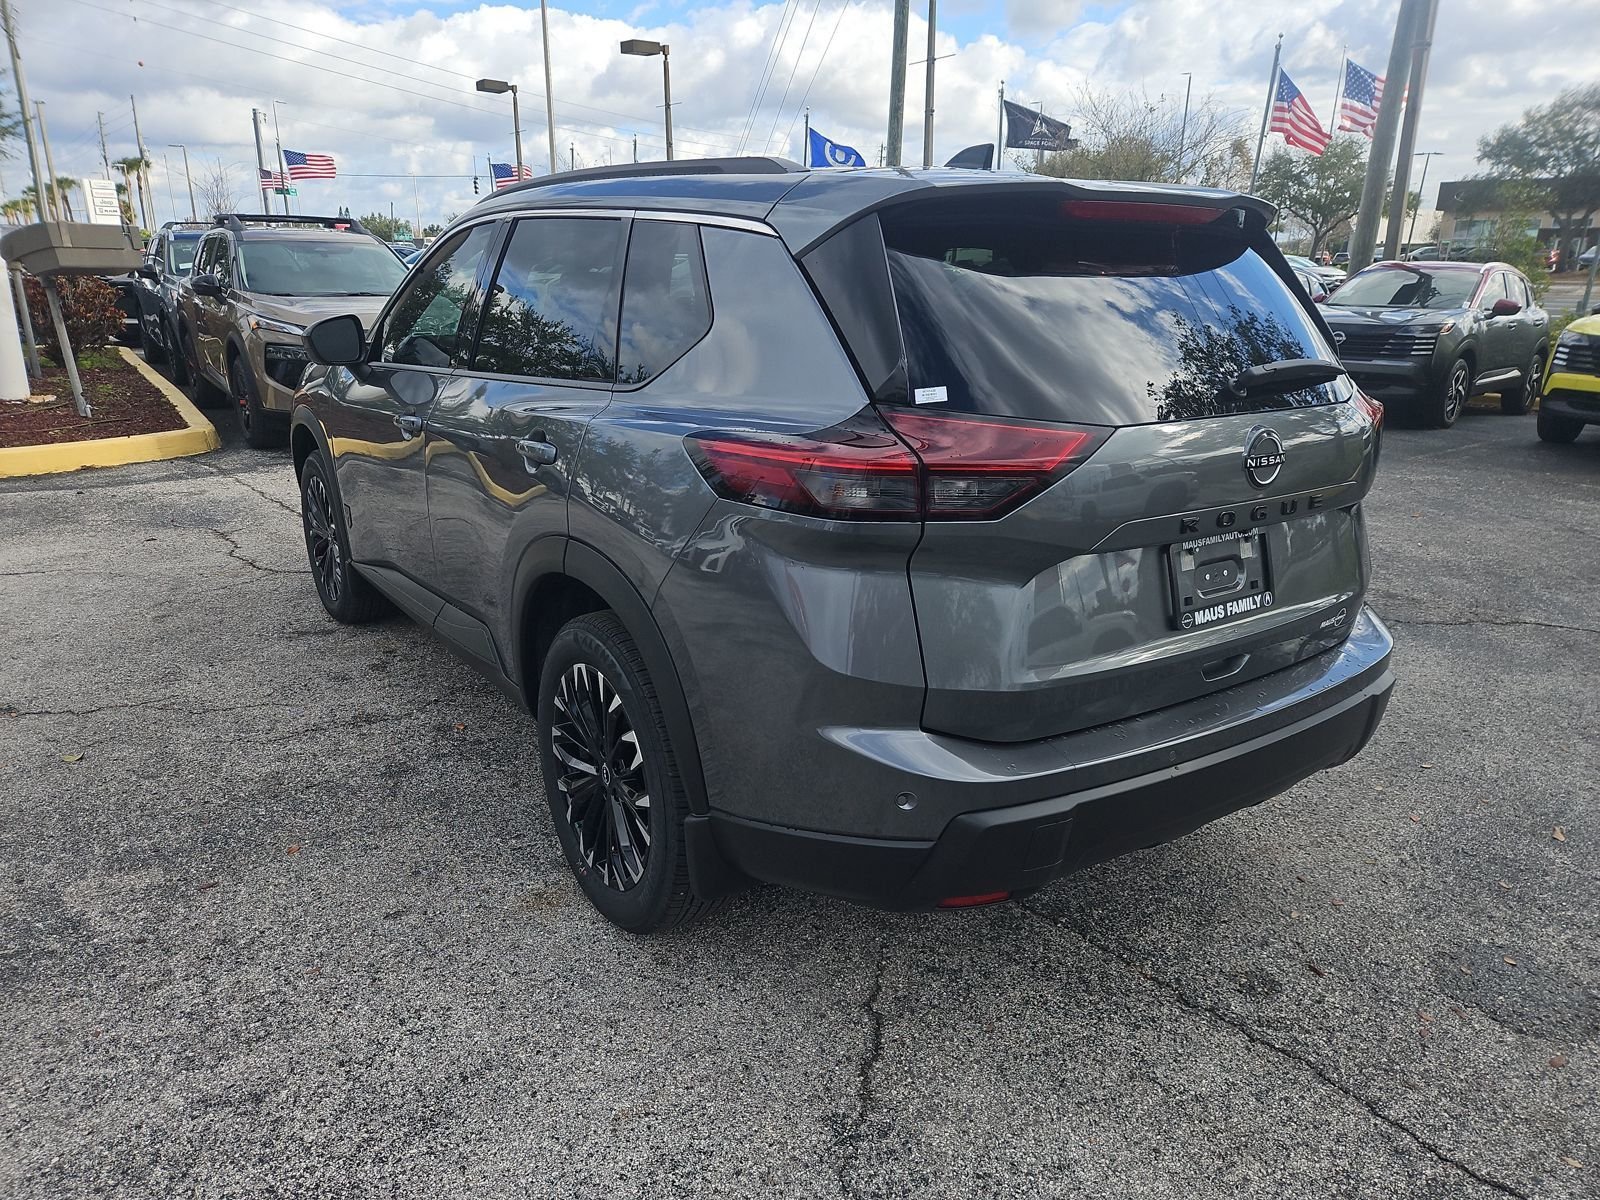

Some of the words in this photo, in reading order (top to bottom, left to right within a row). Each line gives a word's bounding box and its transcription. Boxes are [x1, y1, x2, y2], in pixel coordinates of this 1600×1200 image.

[1247, 453, 1286, 468] NISSAN
[1180, 494, 1323, 535] ROGUE
[1194, 604, 1225, 626] MAUS
[1226, 594, 1262, 616] FAMILY
